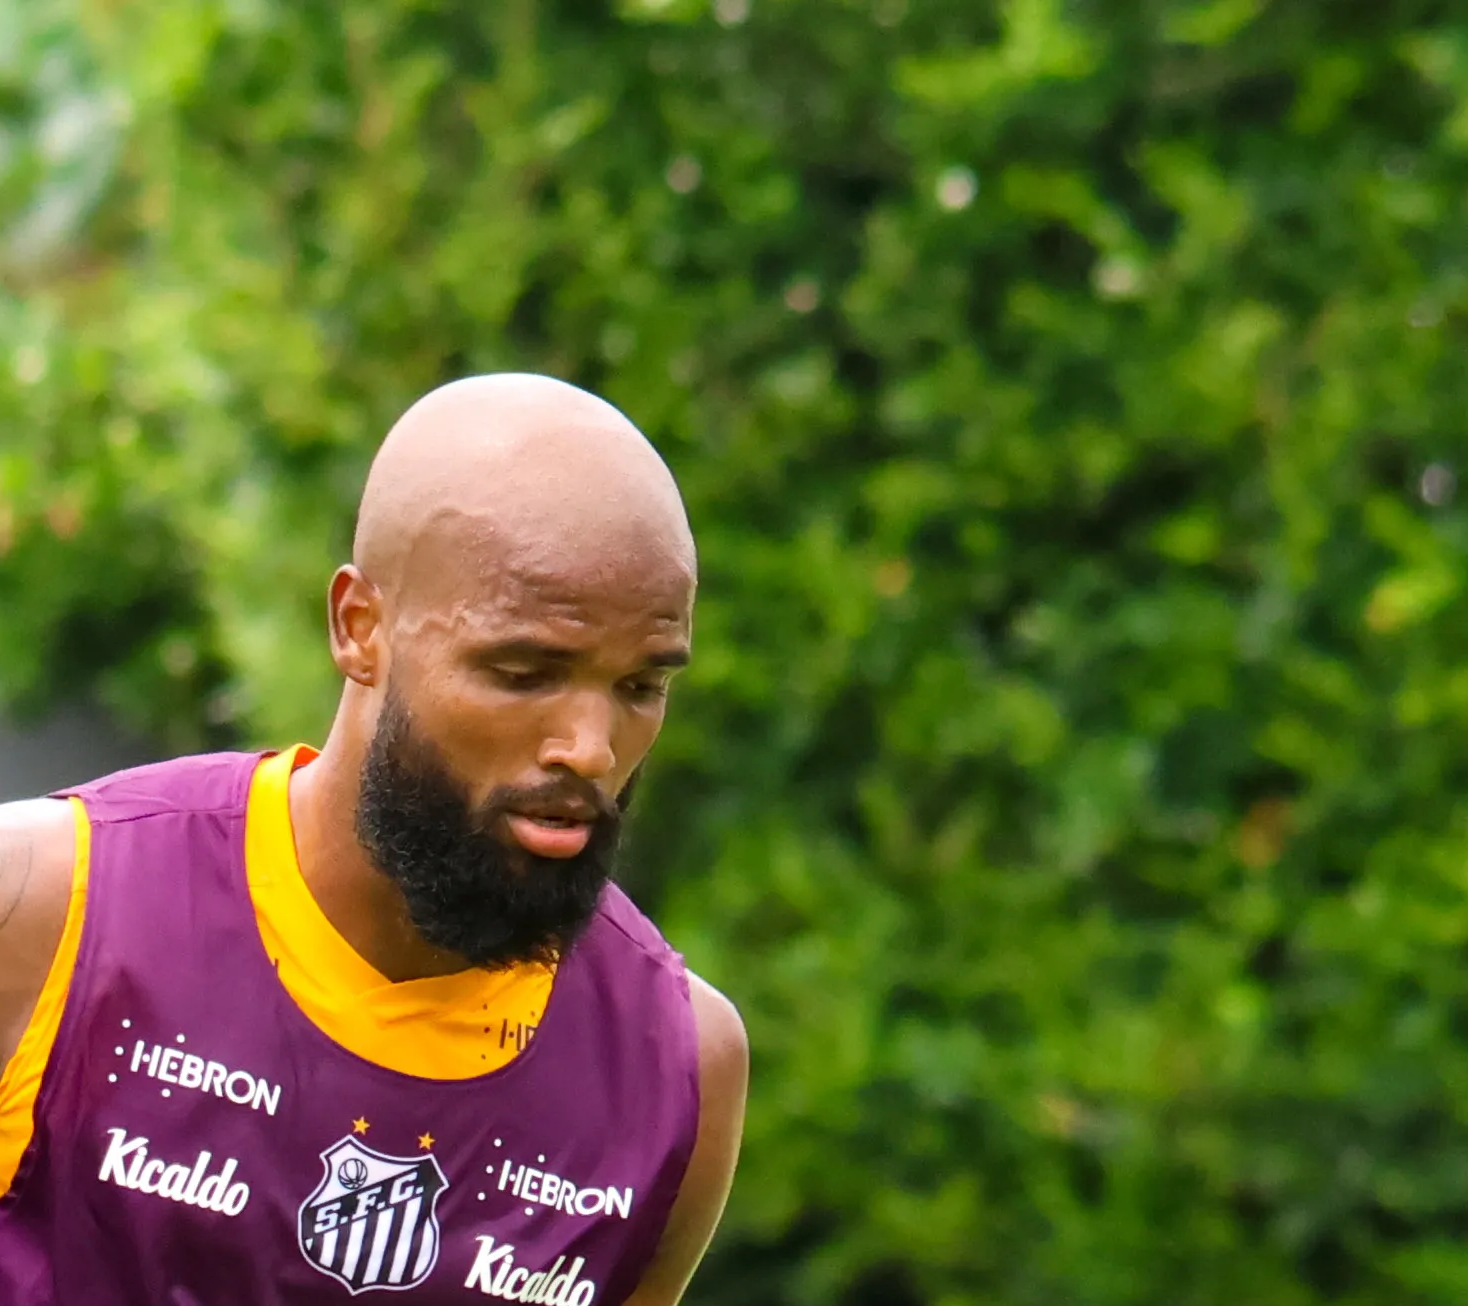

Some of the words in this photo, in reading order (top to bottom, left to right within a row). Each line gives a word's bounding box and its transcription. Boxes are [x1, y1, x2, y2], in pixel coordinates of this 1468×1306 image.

[129, 1039, 282, 1117] HEBRON
[97, 1127, 251, 1217] Kicaldo
[314, 1171, 425, 1235] S.F.C.
[497, 1159, 634, 1220] HEBRON
